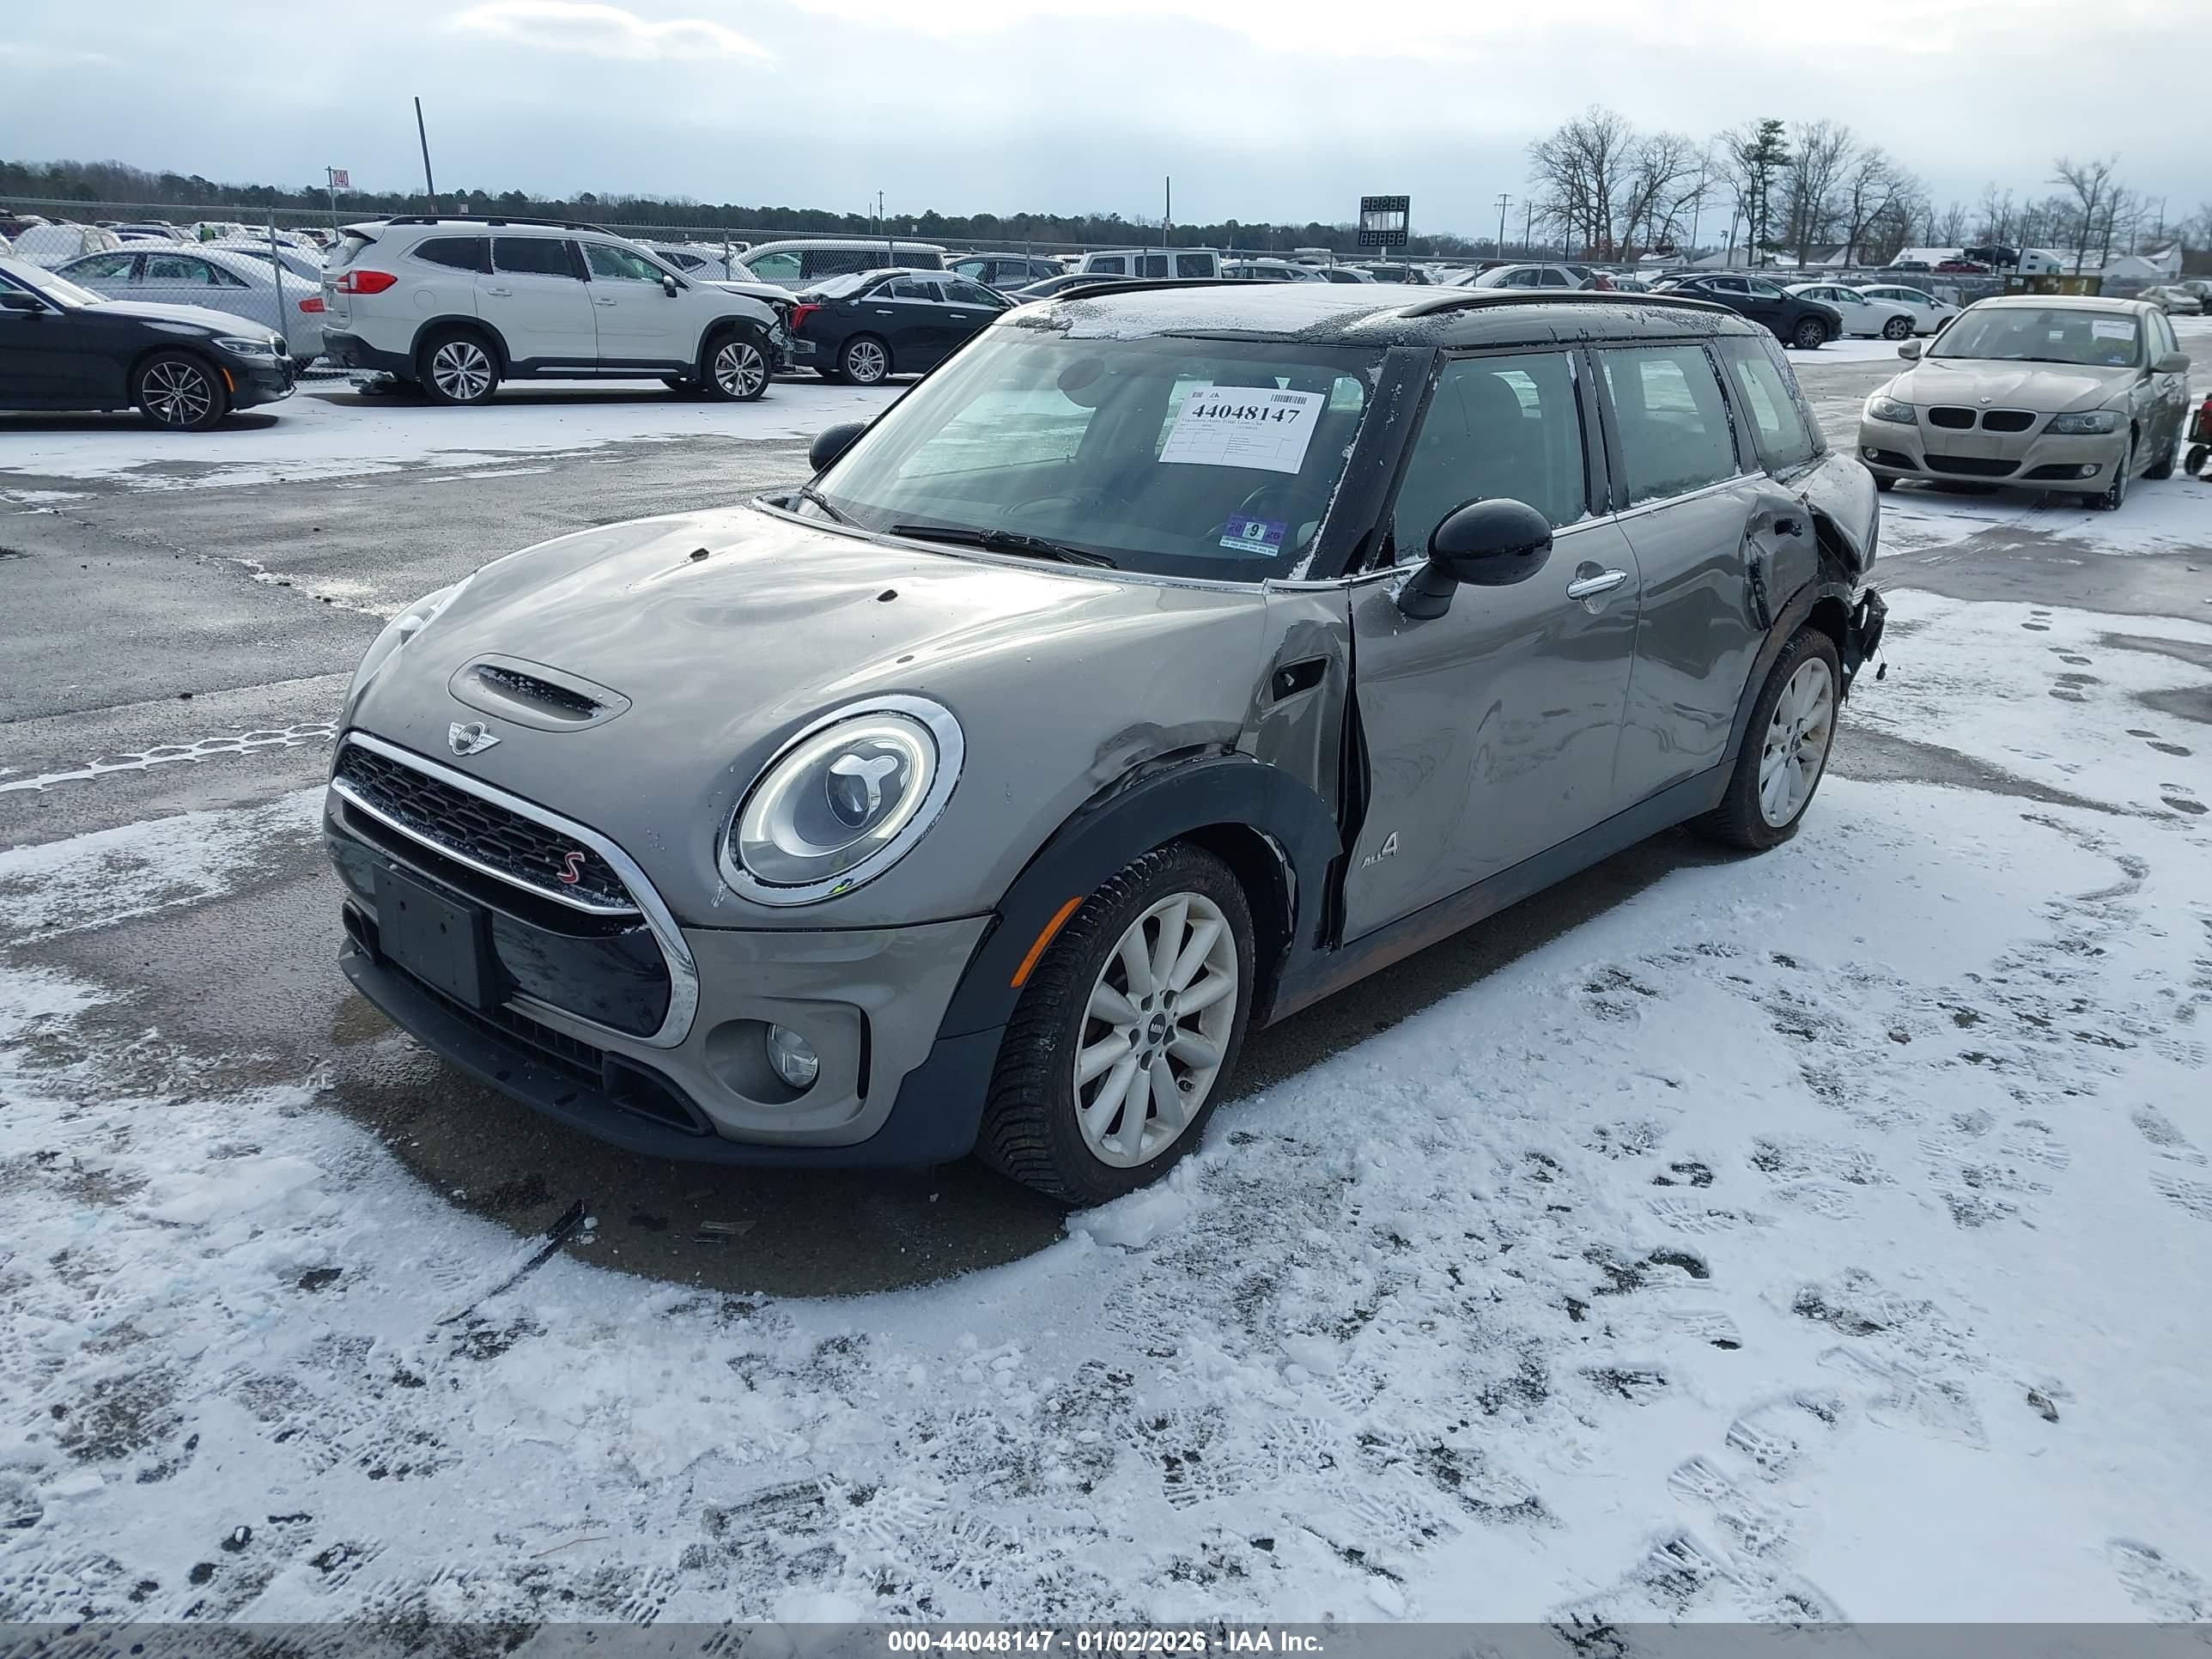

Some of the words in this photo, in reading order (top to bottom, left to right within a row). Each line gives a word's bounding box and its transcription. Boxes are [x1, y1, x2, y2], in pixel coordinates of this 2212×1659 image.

[333, 171, 349, 185] 240
[1192, 404, 1301, 423] 44048147
[1249, 524, 1260, 537] 9
[458, 730, 477, 744] MINI
[556, 851, 585, 884] S
[1151, 1023, 1164, 1035] MINI
